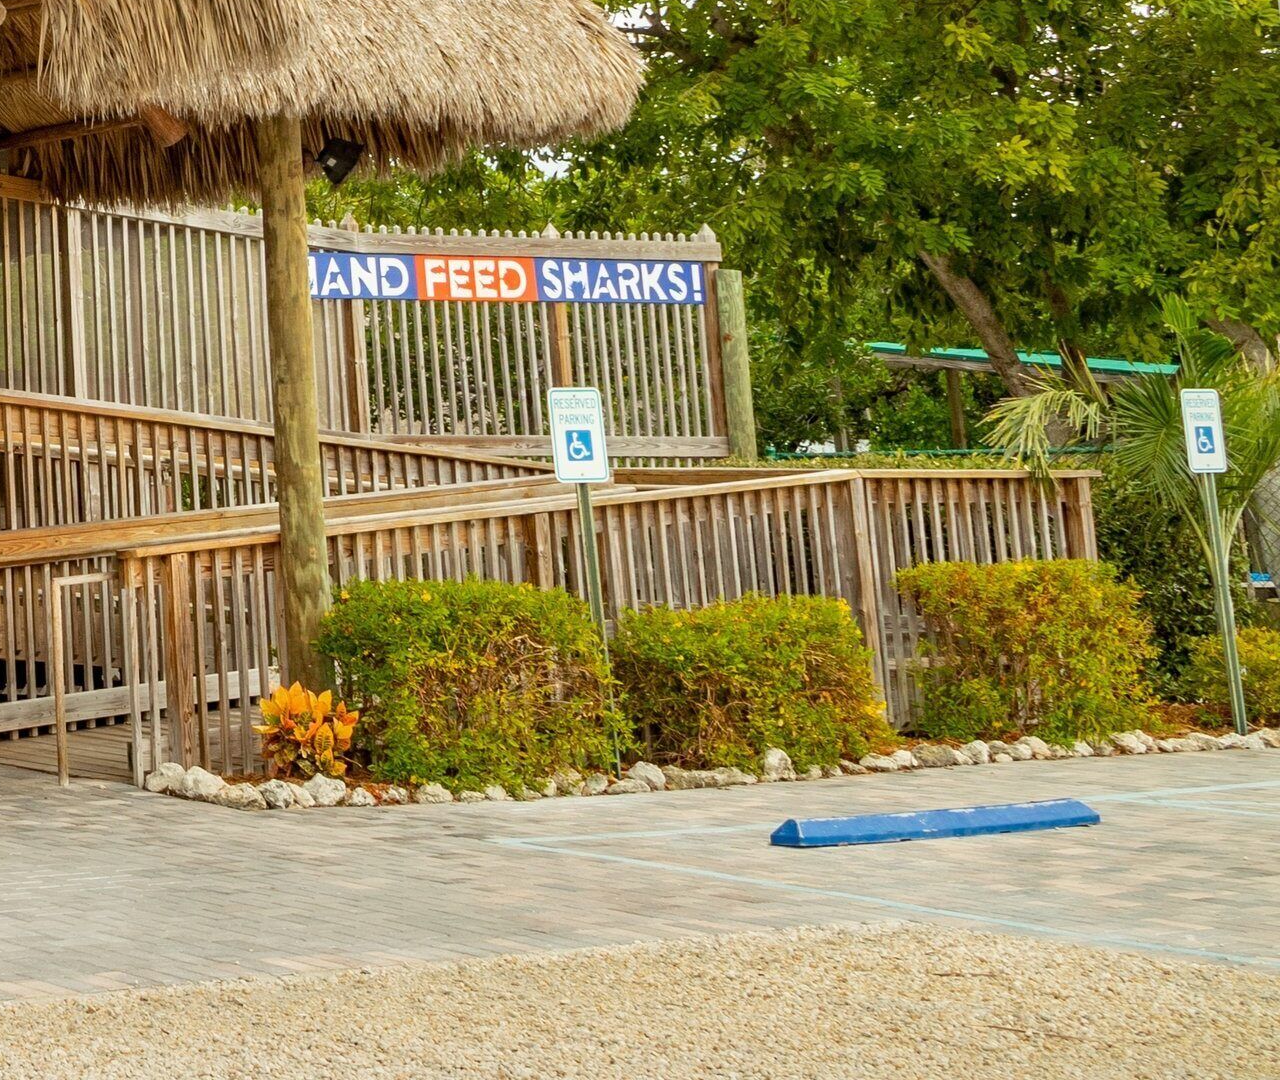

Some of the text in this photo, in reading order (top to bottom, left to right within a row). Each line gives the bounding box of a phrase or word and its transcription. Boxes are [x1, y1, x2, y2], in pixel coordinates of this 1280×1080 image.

[424, 258, 528, 300] FEED
[542, 258, 702, 303] SHARKS!
[553, 398, 595, 409] RESERVED
[559, 414, 594, 424] PARKING
